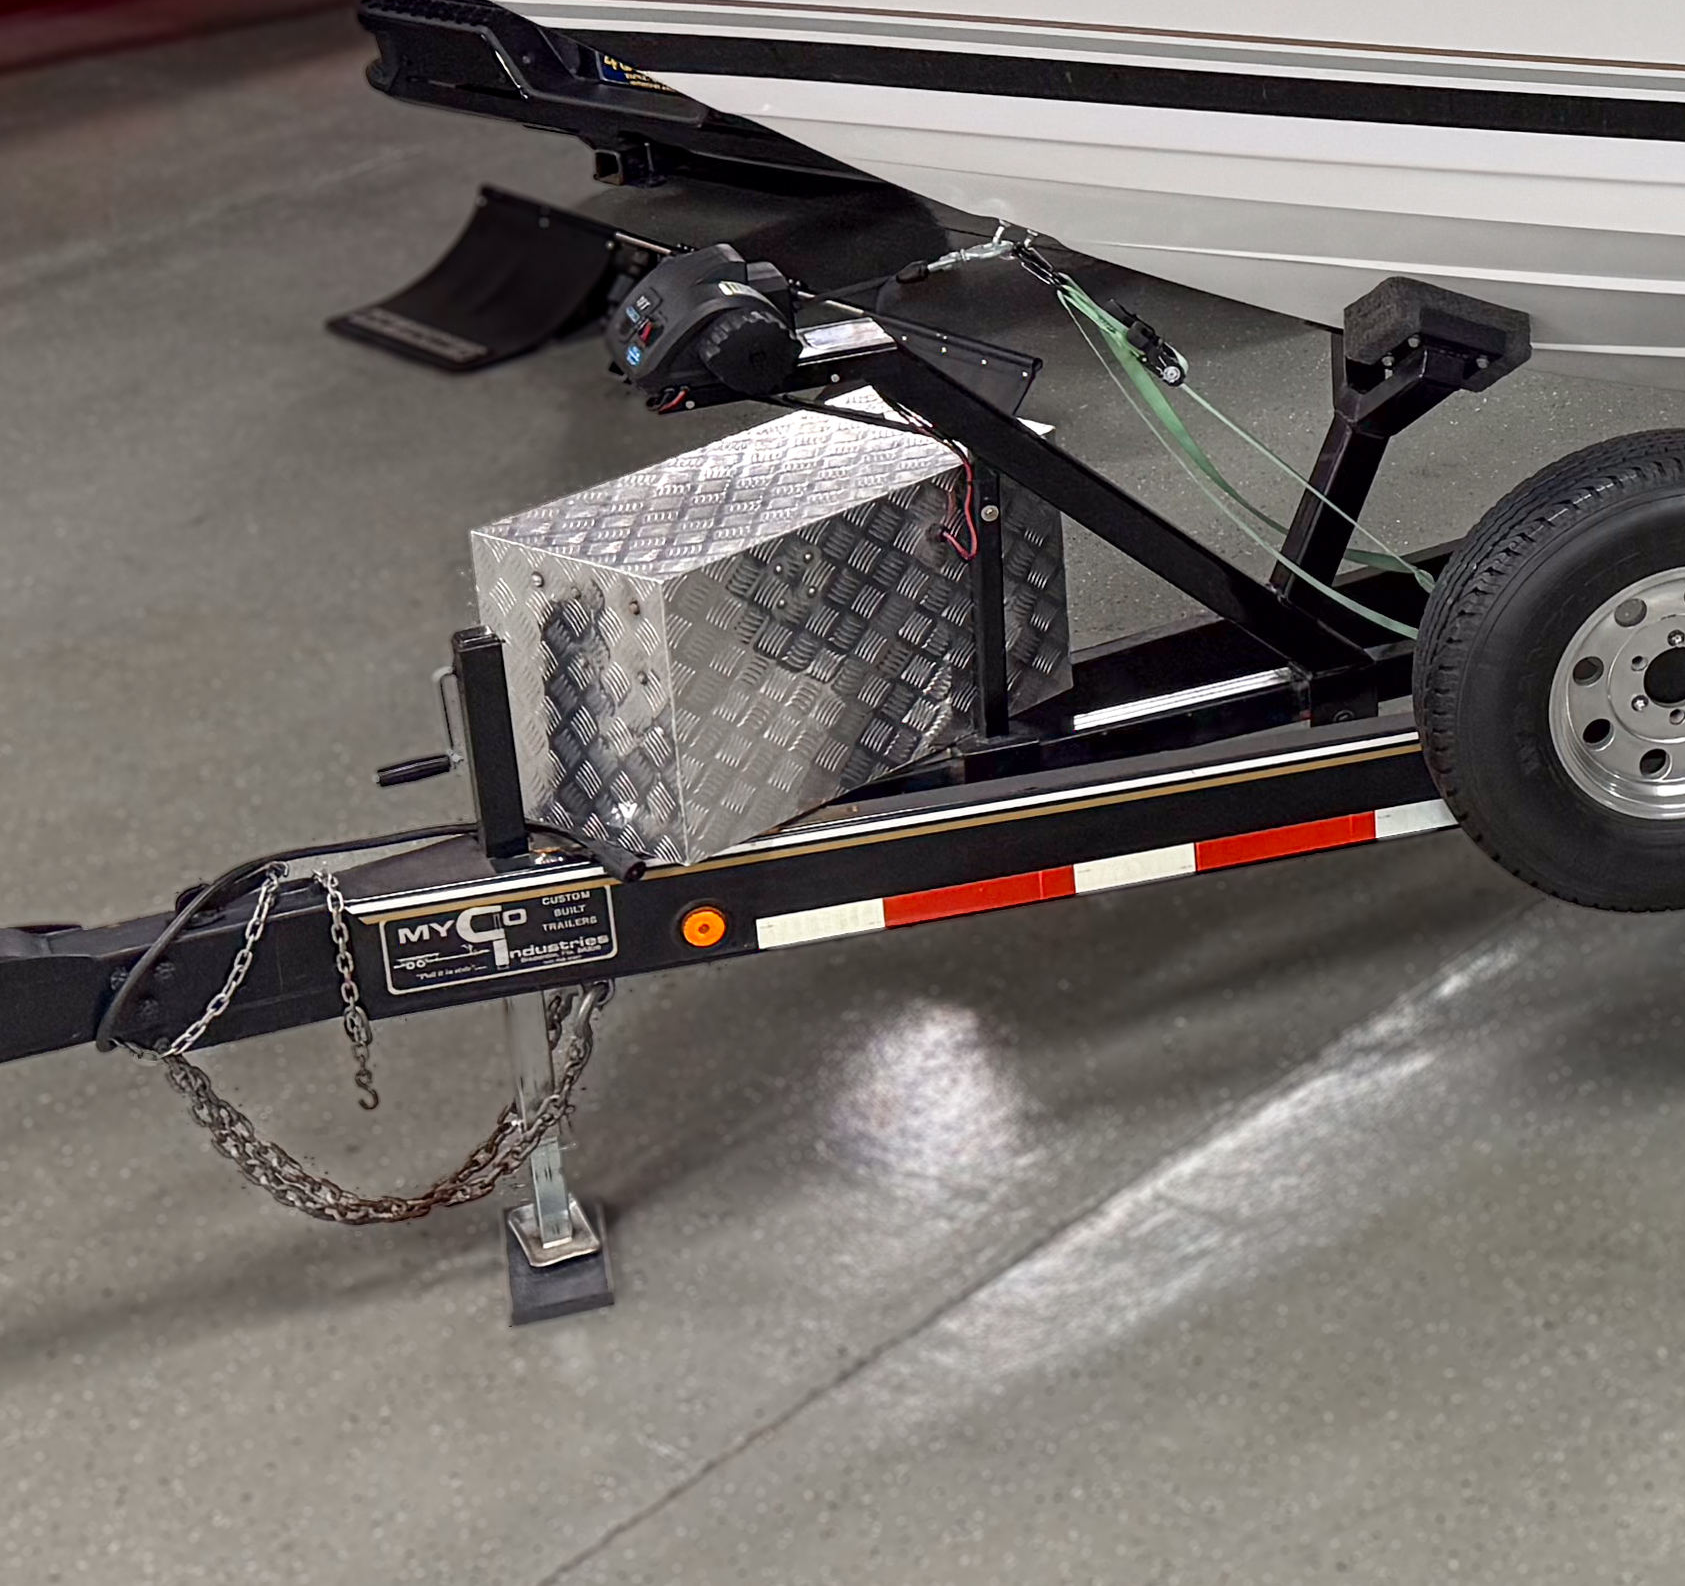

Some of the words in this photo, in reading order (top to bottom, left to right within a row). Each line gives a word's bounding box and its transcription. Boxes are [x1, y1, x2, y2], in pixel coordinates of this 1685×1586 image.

[541, 890, 591, 907] CUSTOM
[552, 903, 587, 918] BUILT
[541, 915, 598, 933] TRAILERS
